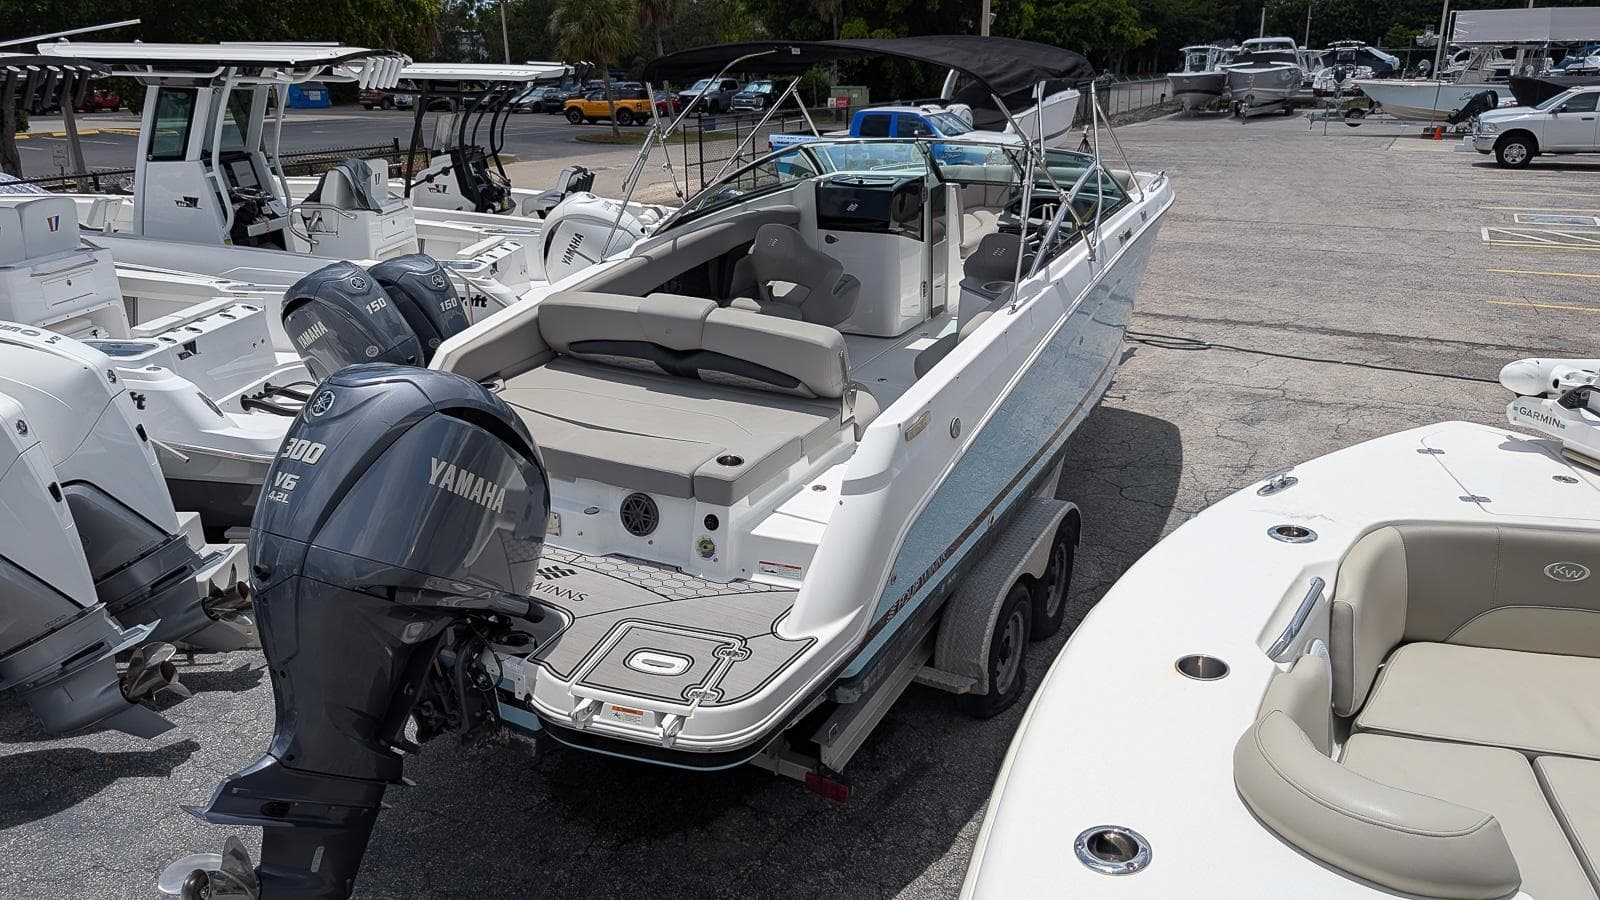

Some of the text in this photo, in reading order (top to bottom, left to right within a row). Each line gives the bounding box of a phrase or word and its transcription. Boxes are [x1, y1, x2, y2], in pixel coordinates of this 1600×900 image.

[561, 233, 584, 265] YAMAHA
[365, 298, 387, 315] 150
[297, 320, 328, 350] YAMAHA
[1519, 406, 1560, 428] GARMIN
[281, 437, 327, 465] 300
[274, 471, 300, 491] V6
[428, 456, 506, 514] YAMAHA
[267, 490, 289, 504] 4.2L
[1553, 565, 1583, 578] KW
